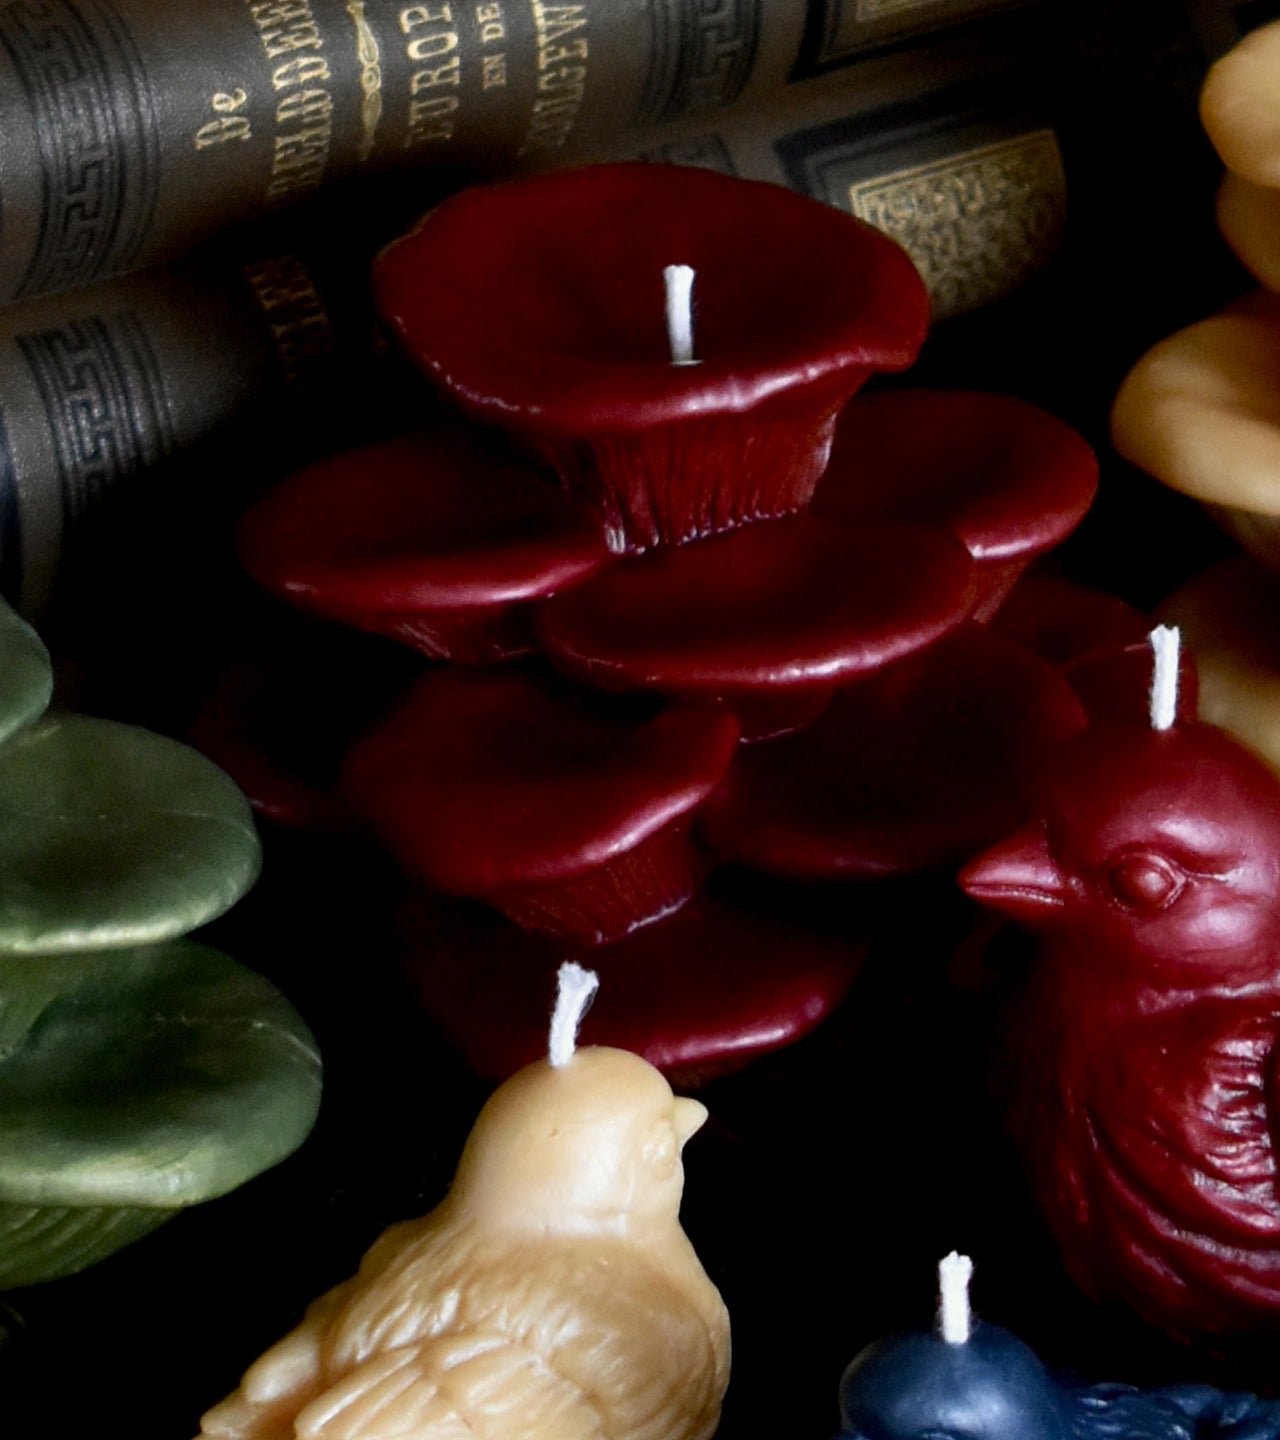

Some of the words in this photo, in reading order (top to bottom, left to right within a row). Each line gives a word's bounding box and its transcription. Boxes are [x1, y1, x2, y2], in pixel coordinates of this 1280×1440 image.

[475, 2, 506, 44] DE
[481, 53, 507, 91] EN
[195, 87, 254, 151] De
